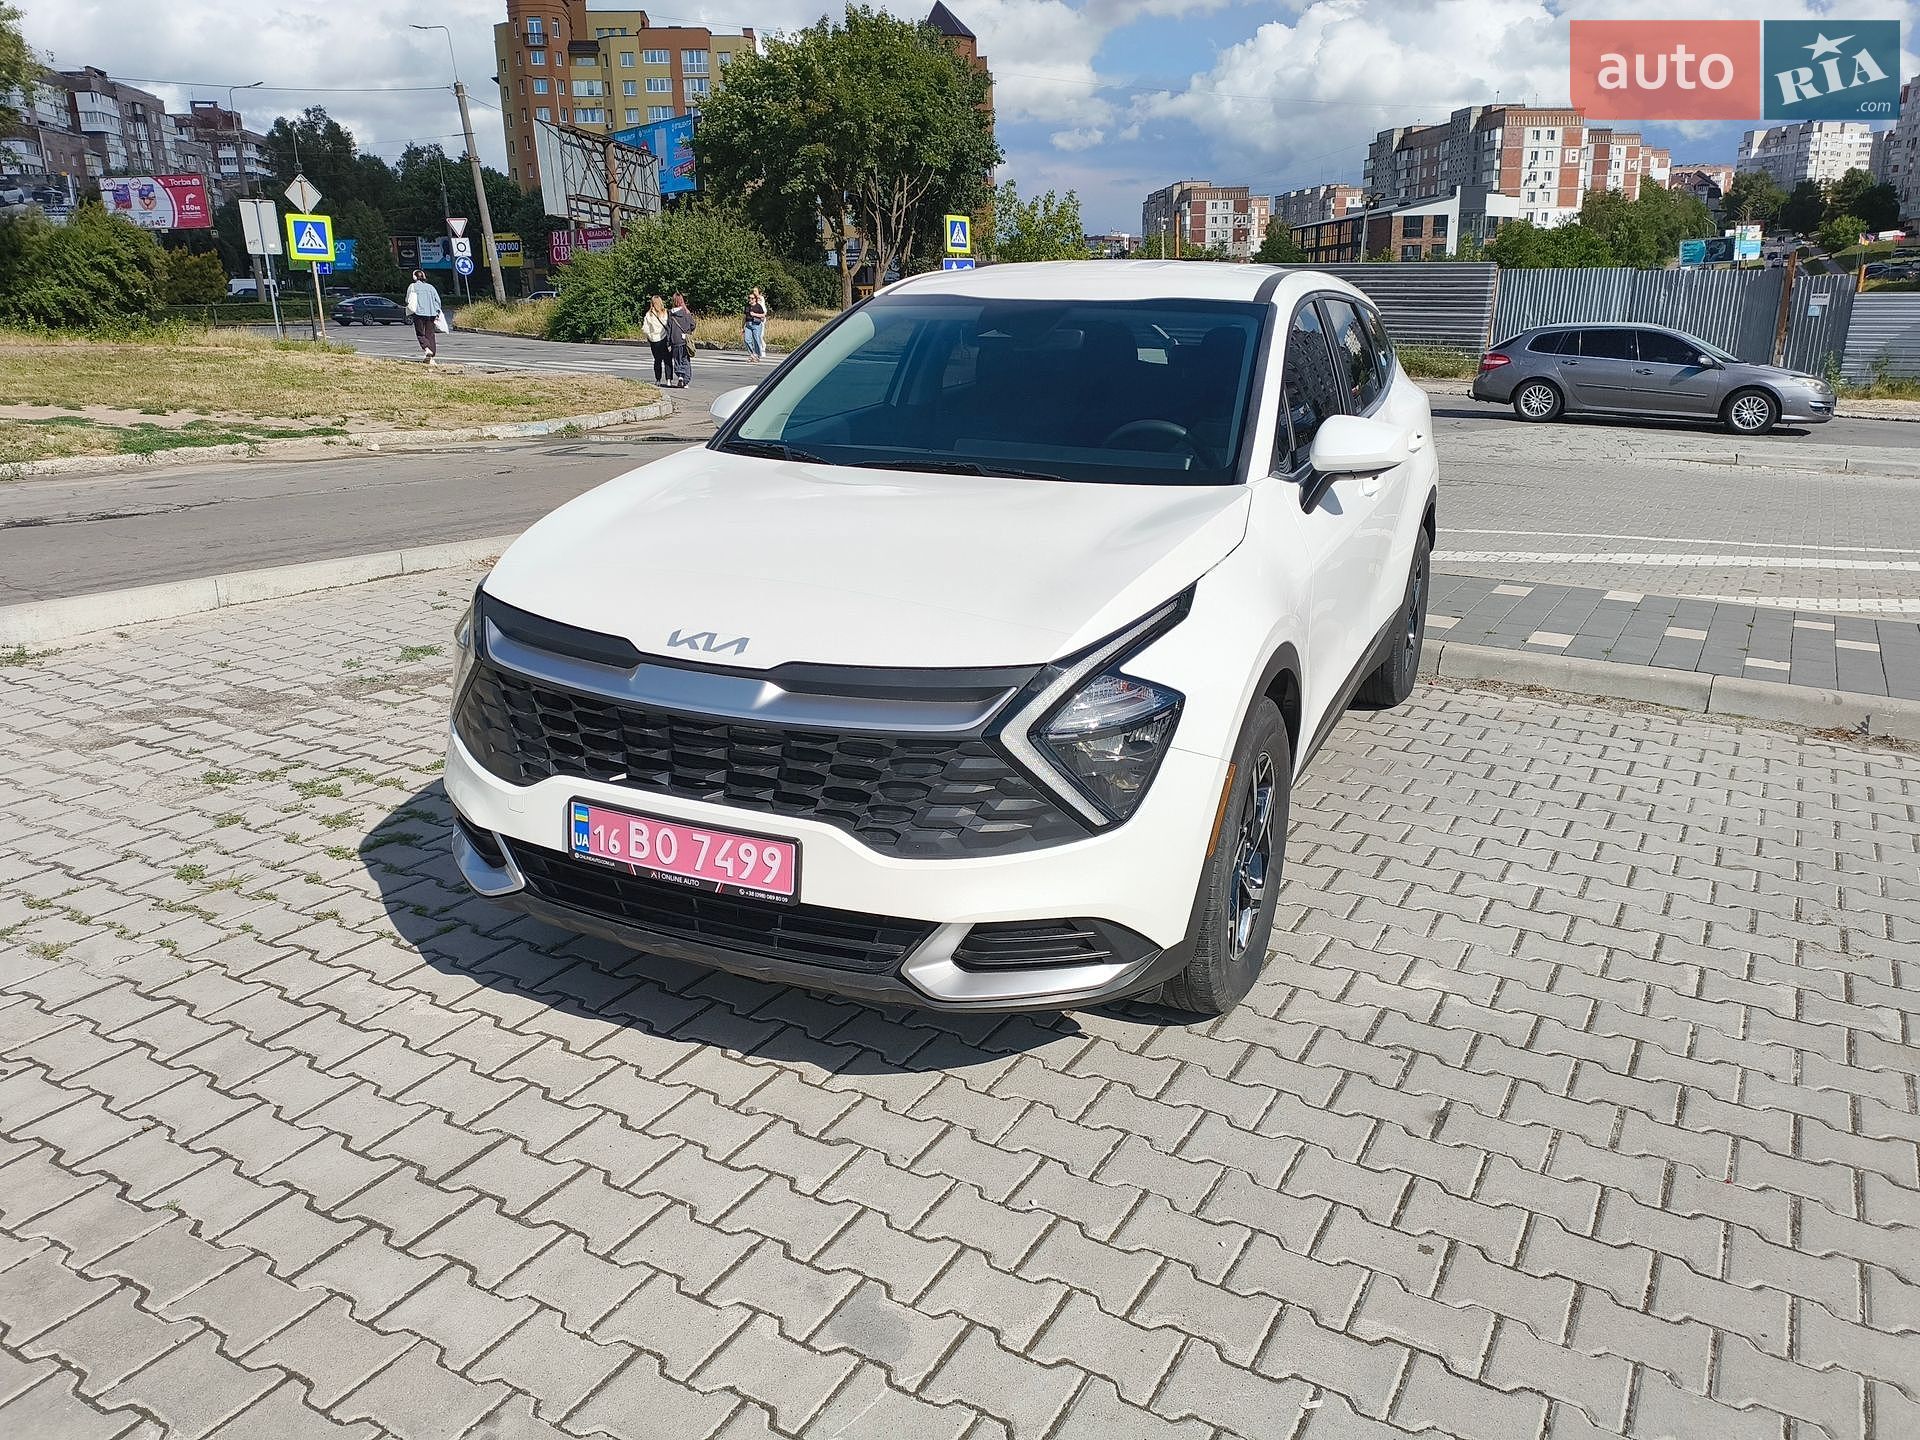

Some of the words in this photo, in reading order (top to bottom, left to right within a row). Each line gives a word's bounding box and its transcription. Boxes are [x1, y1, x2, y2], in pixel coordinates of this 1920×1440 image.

[1627, 160, 1638, 171] 14
[168, 178, 191, 186] Torba
[1234, 214, 1248, 225] 20
[552, 230, 586, 246] ВИА
[666, 629, 751, 657] KIA
[575, 832, 589, 848] UA
[592, 824, 620, 854] 16
[692, 835, 782, 884] 7499
[661, 872, 683, 884] ONLINE
[683, 878, 700, 887] AUTO
